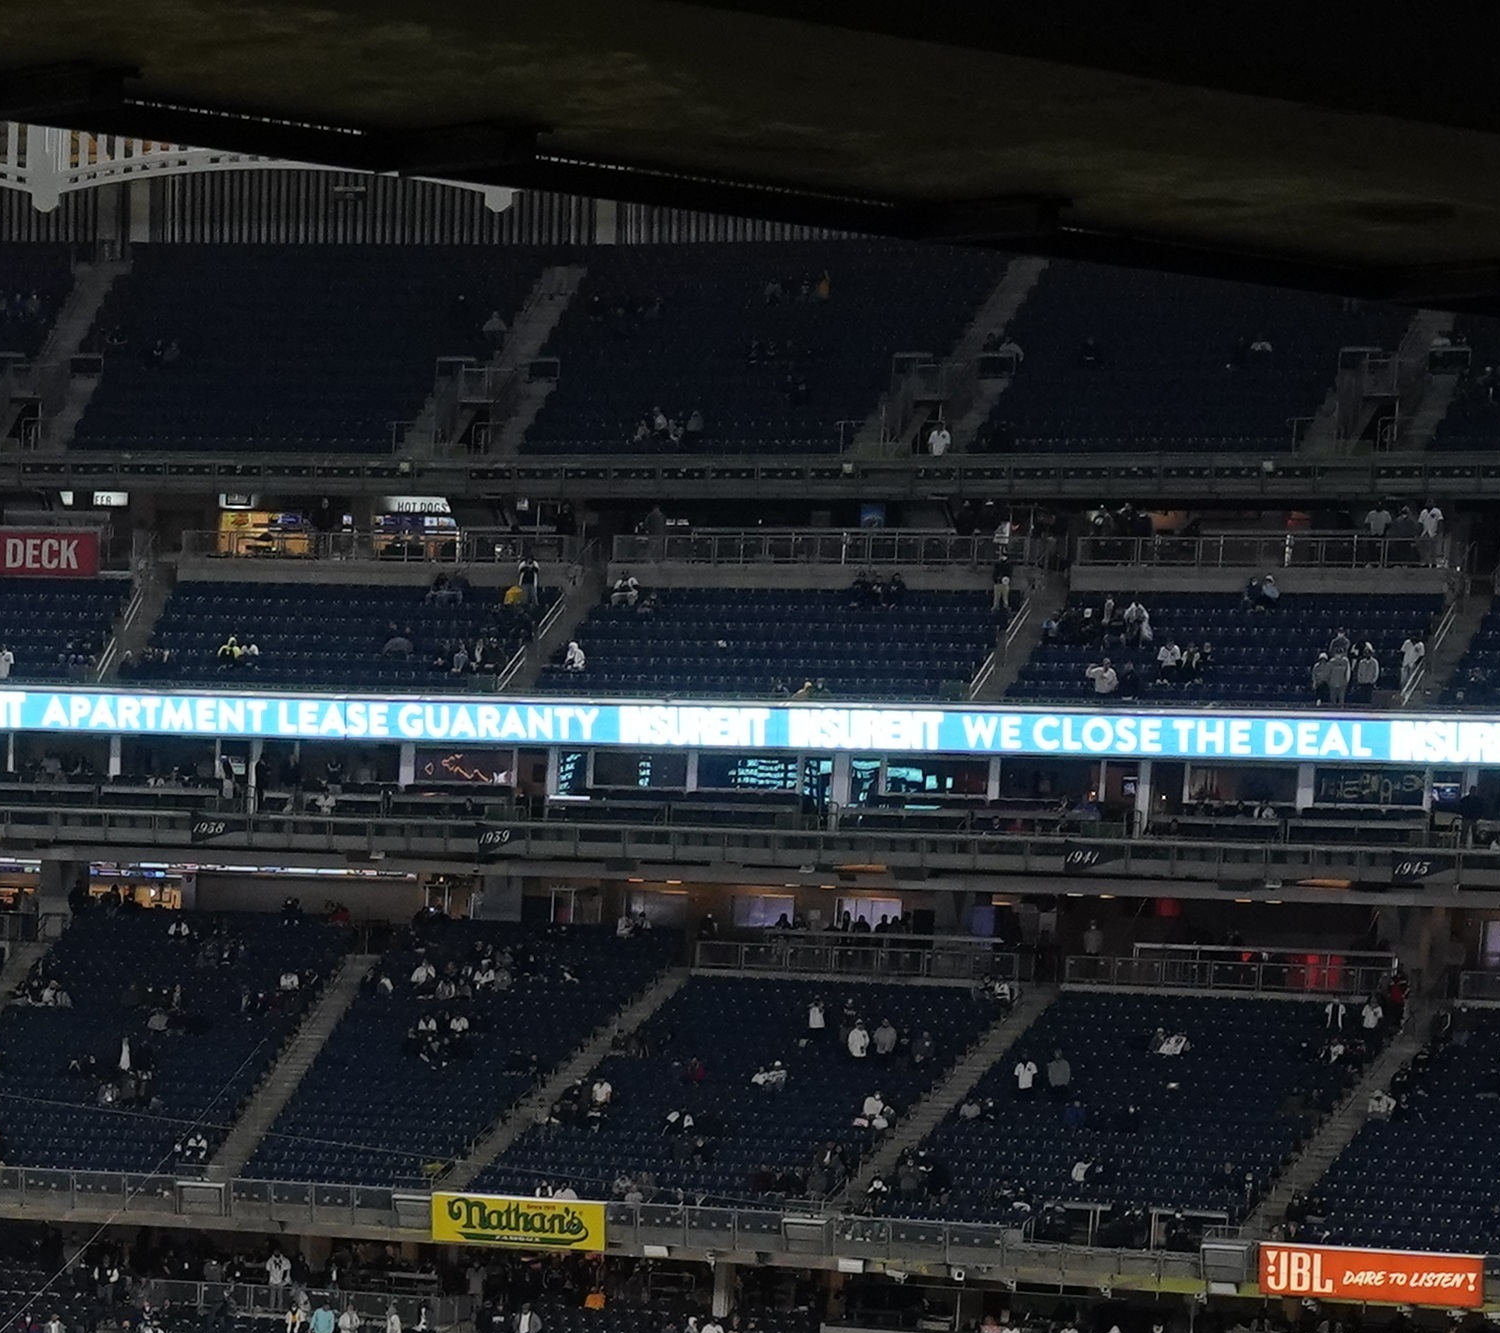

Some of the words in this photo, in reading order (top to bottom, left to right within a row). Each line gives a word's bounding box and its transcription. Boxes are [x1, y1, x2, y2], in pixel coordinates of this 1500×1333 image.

[396, 501, 417, 513] HOT
[419, 502, 447, 514] DOGS
[5, 538, 78, 570] DECK
[41, 695, 267, 732] APARTMENT
[278, 701, 389, 736] LEASE
[398, 703, 599, 741] GUARANTY
[961, 715, 1022, 750] WE
[1032, 717, 1162, 753] CLOSE
[1173, 719, 1252, 754] THE
[1264, 721, 1372, 757] DEAL
[447, 1198, 584, 1236] Nathan's
[1266, 1251, 1334, 1293] JBL
[1342, 1270, 1386, 1286] DARE
[1388, 1272, 1407, 1285] TO
